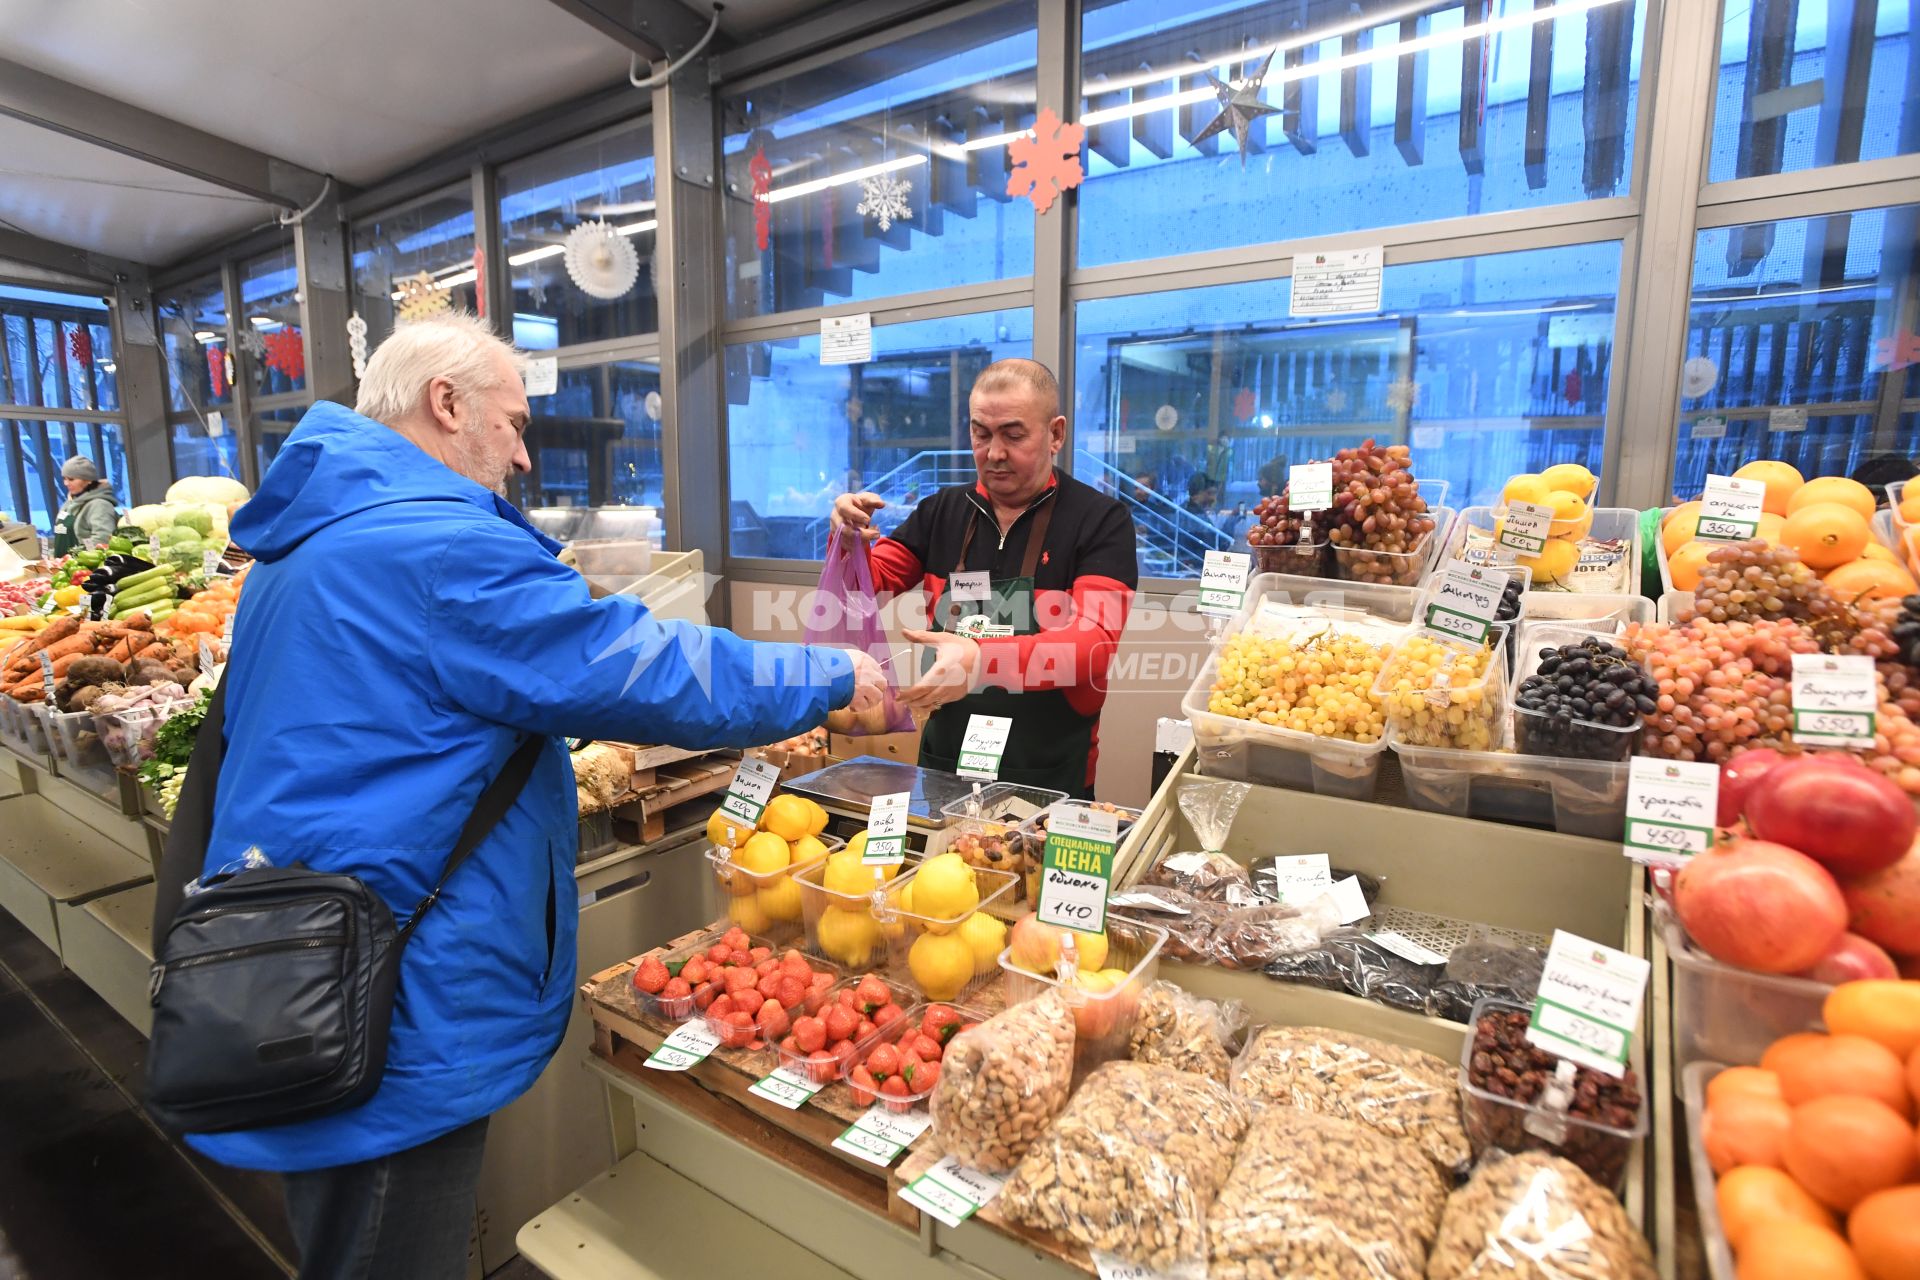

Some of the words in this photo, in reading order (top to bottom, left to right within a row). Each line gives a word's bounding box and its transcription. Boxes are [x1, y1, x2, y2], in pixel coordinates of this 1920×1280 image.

[1444, 617, 1473, 631] 550
[1050, 835, 1112, 855] СПЕЦИАЛЬНАЯ
[1054, 847, 1102, 874] ЦЕНА
[1054, 901, 1092, 919] 140
